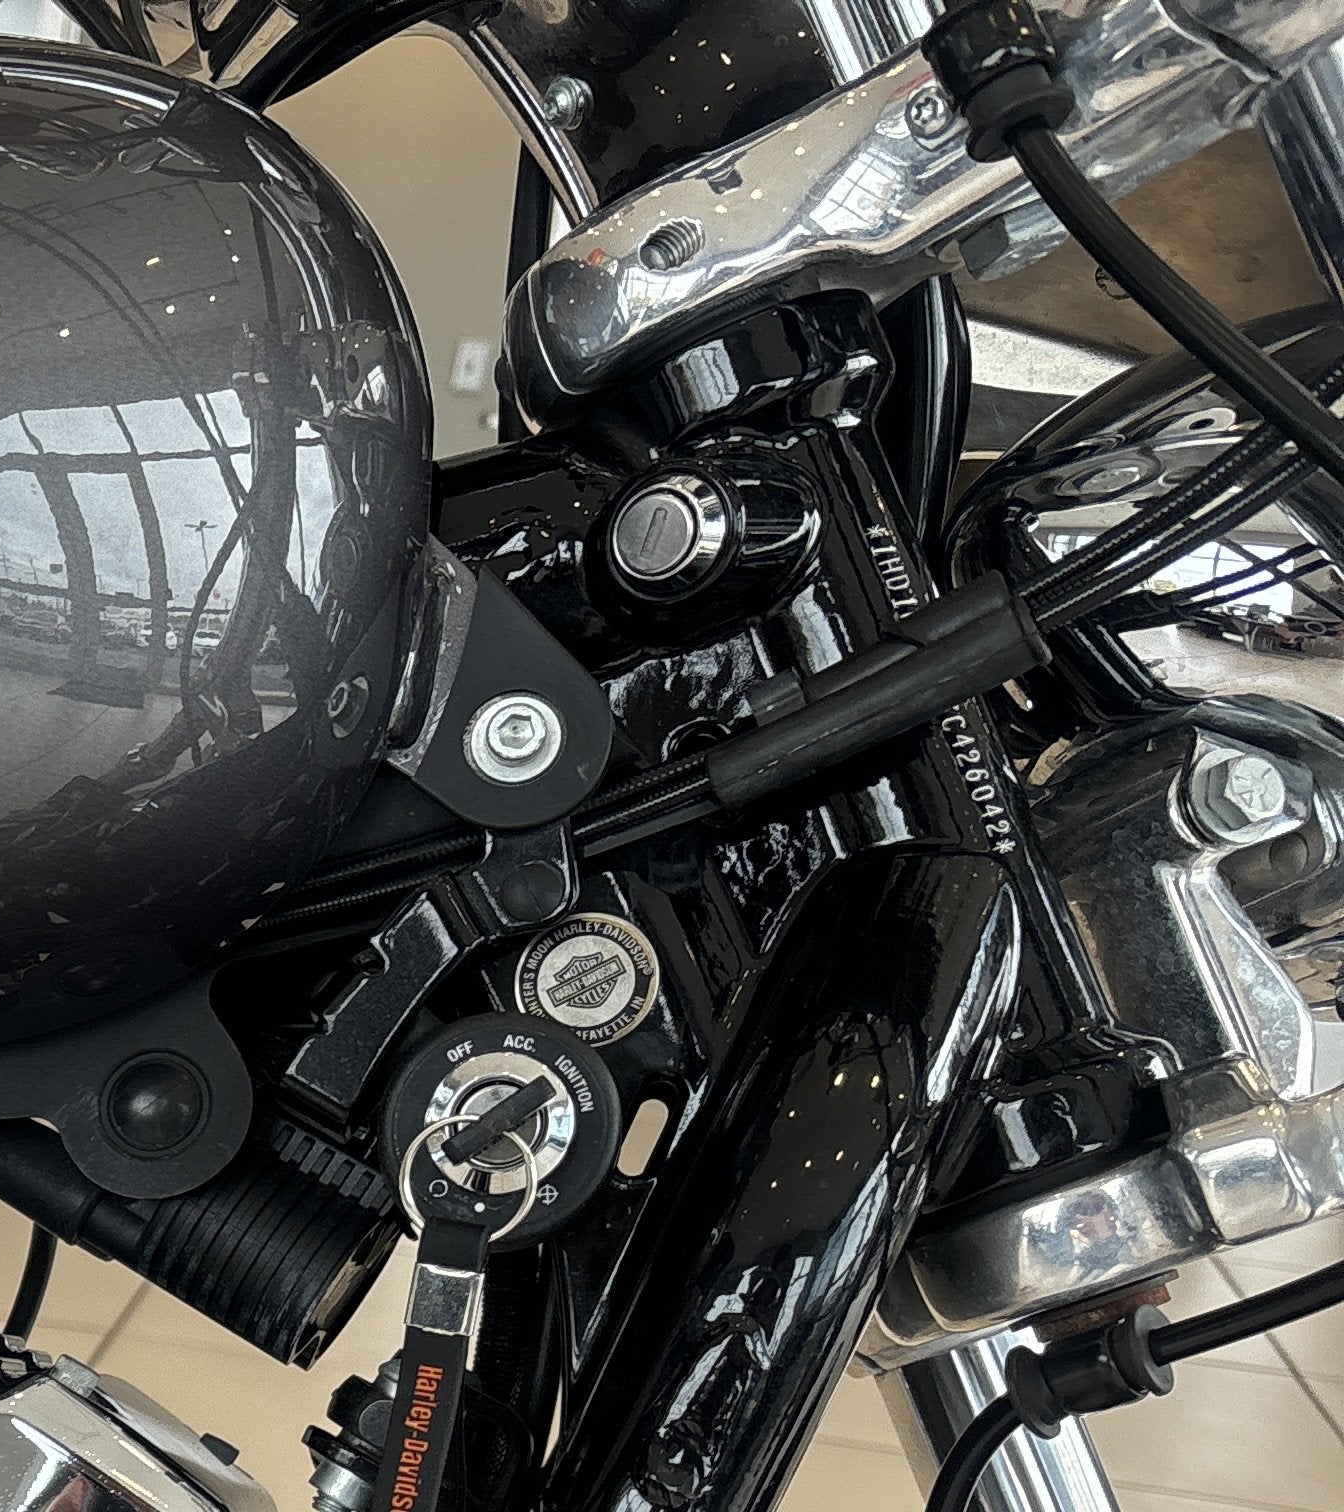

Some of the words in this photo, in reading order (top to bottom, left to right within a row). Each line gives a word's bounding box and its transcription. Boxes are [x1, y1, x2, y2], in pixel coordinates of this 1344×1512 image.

[526, 937, 555, 970] MOON
[562, 958, 602, 981] MOTOR
[630, 995, 646, 1010] IN
[446, 1040, 474, 1063] OFF
[502, 1033, 536, 1053] ACC.
[553, 1054, 595, 1114] IGNITION
